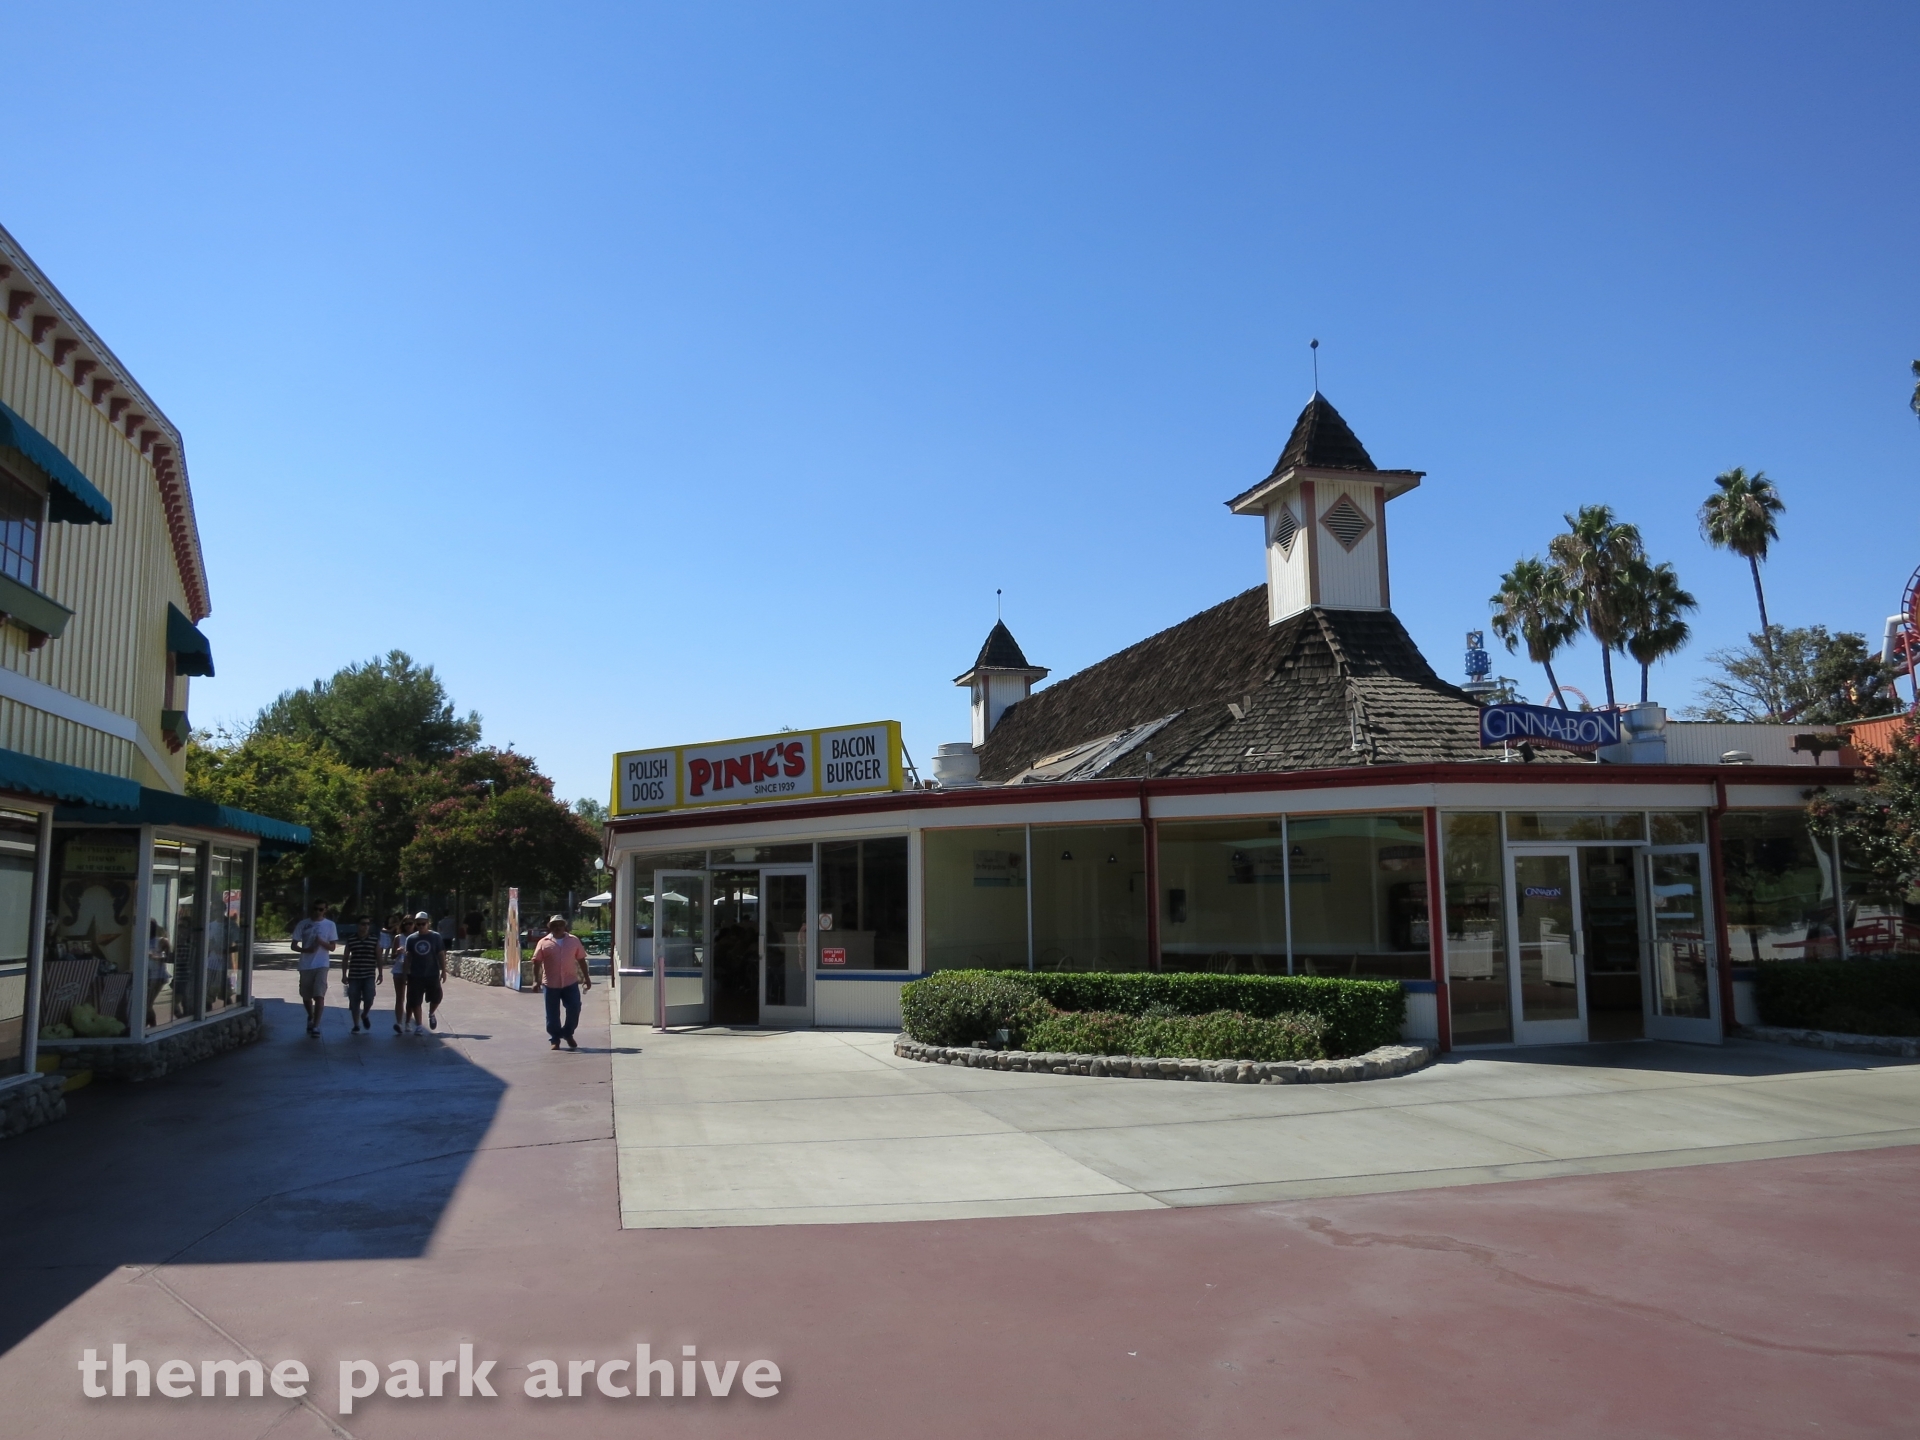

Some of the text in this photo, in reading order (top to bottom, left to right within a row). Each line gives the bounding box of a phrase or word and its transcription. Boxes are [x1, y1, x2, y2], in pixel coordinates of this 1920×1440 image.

[1482, 708, 1618, 743] CINNABON
[832, 735, 876, 760] BACON
[1529, 737, 1550, 746] FAMOUS
[1551, 741, 1580, 752] CINNAMON
[629, 759, 668, 781] POLISH
[688, 741, 806, 797] PINK'S
[827, 758, 882, 784] BURGER
[632, 780, 665, 802] DOGS
[754, 781, 796, 795] SINCE 1939
